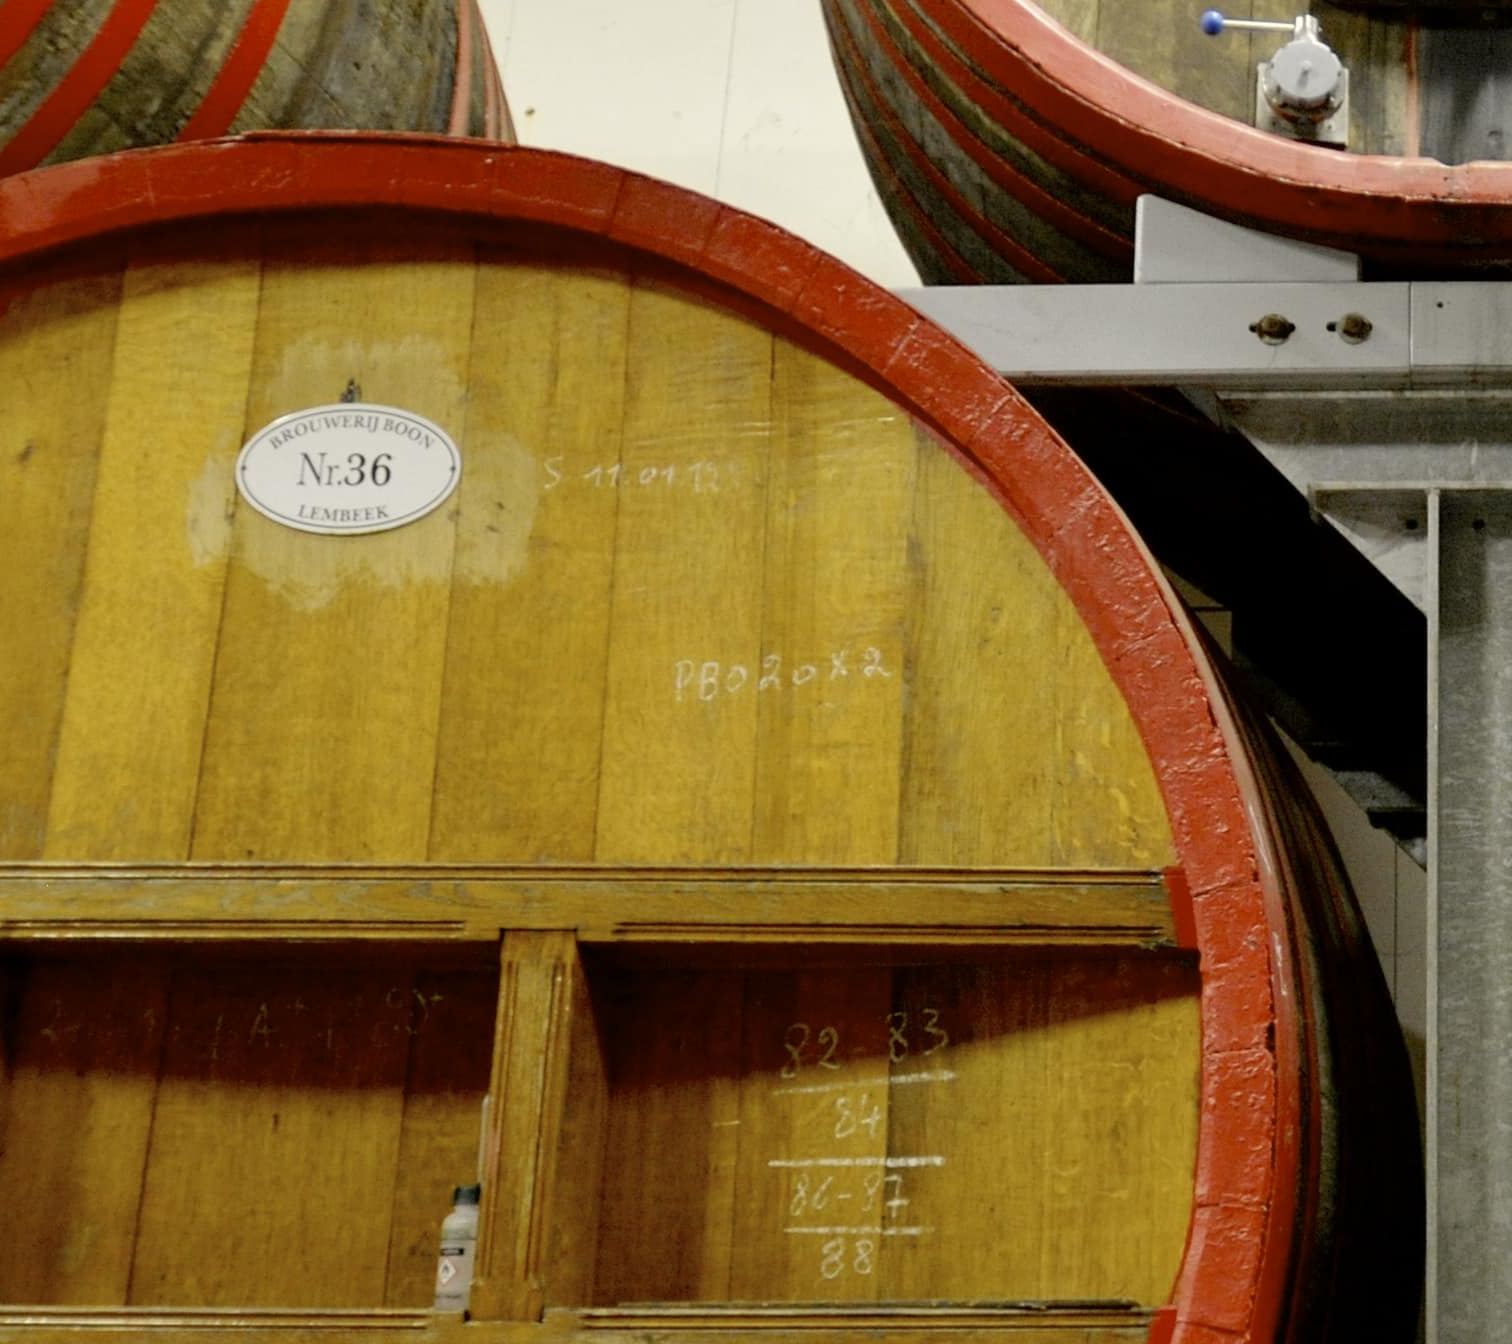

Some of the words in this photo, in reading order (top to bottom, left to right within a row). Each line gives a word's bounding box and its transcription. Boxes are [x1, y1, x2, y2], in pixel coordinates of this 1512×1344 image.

[269, 414, 380, 450] BROUWERIJ
[383, 419, 436, 450] BOON
[297, 504, 391, 522] LEMBEEK
